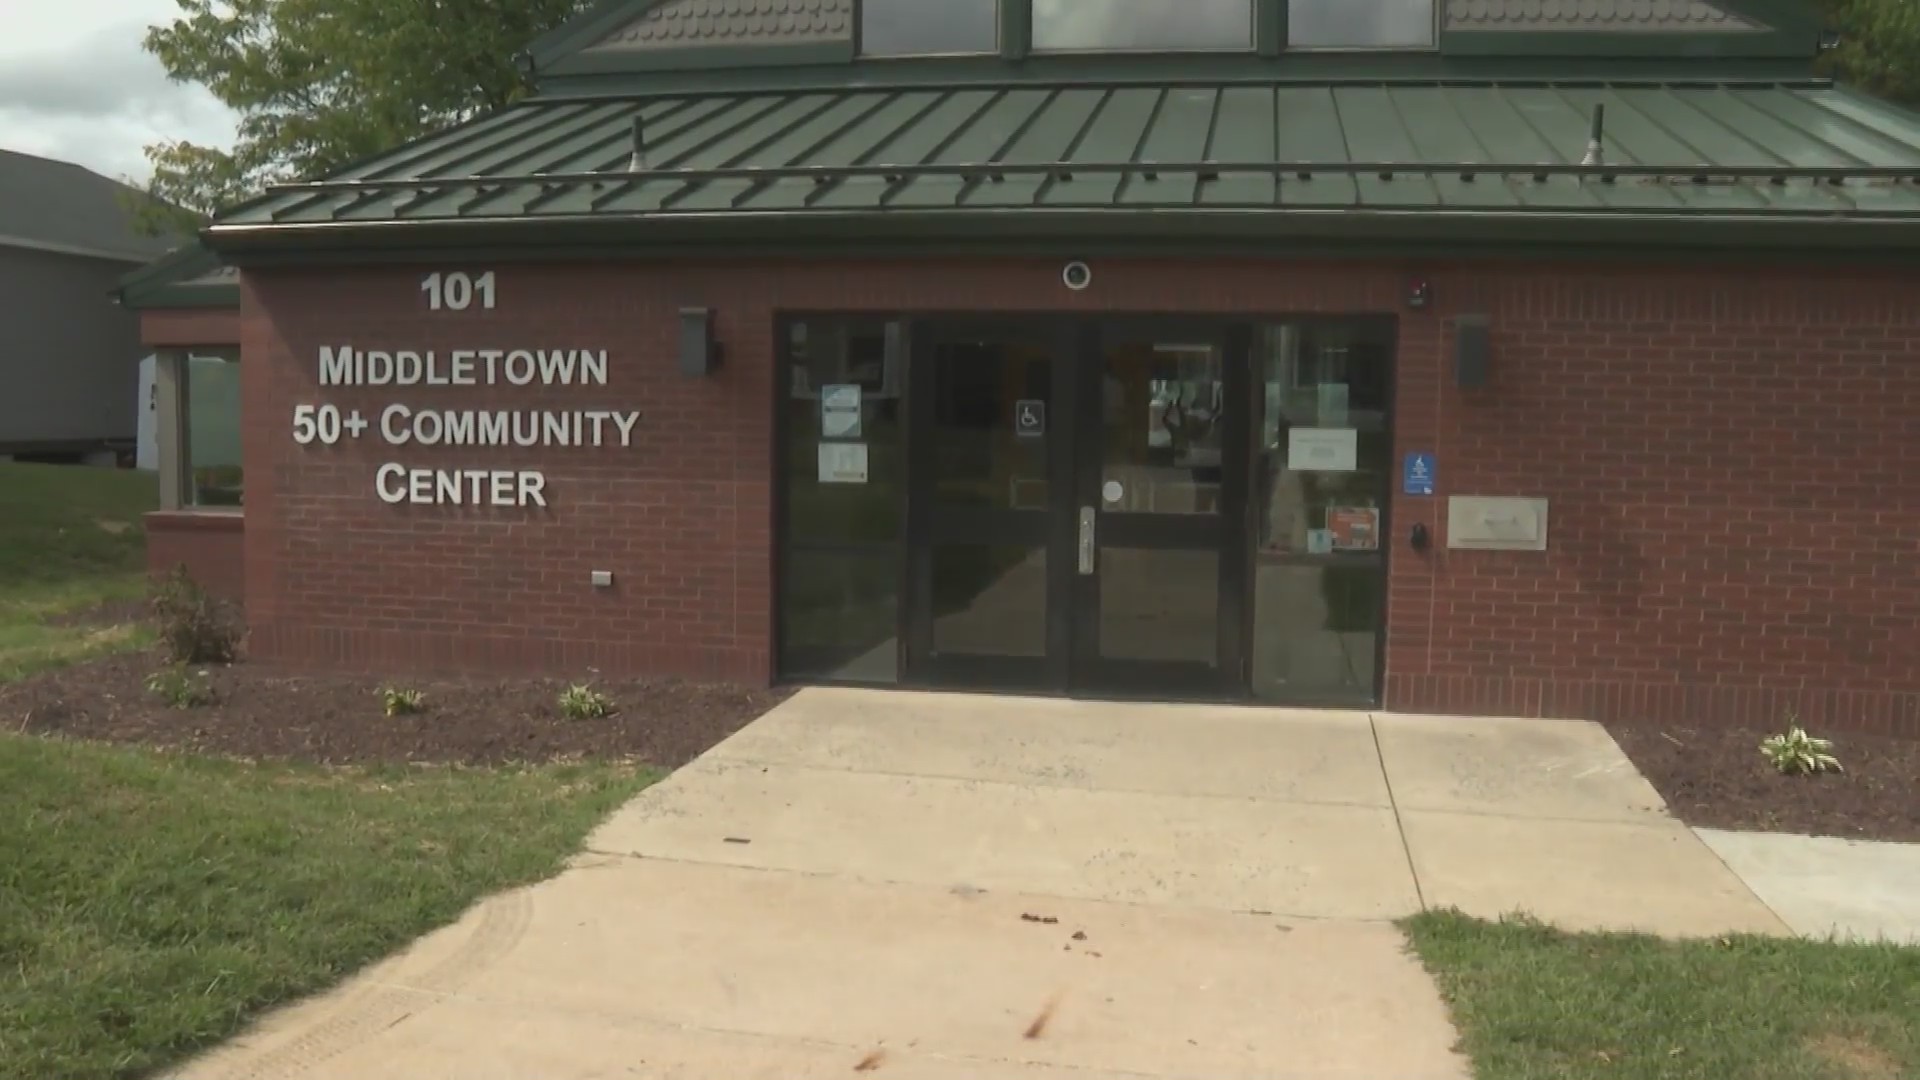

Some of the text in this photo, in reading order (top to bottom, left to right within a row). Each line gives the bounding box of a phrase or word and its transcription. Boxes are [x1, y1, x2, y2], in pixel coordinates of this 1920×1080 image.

[421, 272, 495, 309] 101
[318, 346, 608, 385] MIDDLETOWN
[292, 403, 640, 447] 50+ COMMUNITY
[376, 462, 547, 506] CENTER
